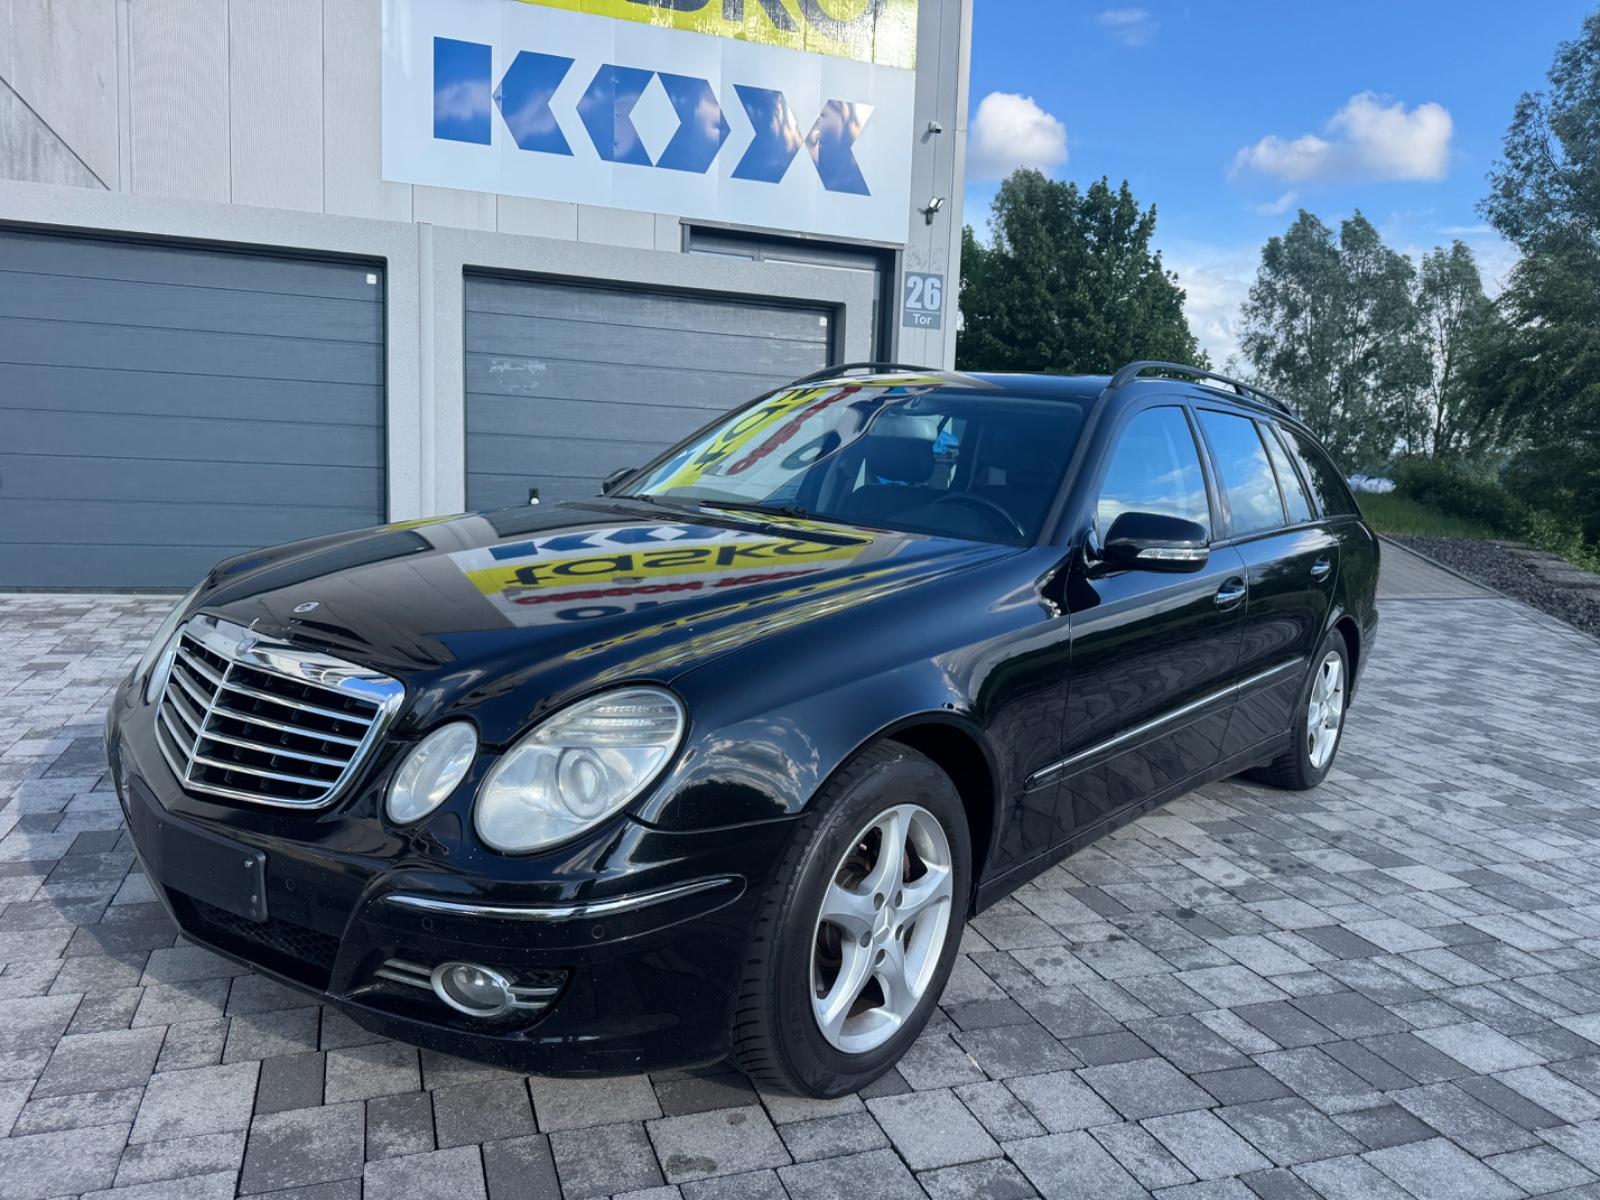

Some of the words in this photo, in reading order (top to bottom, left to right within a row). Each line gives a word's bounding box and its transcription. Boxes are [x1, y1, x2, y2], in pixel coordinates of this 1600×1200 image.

[433, 37, 875, 196] KOX
[906, 276, 941, 310] 26
[912, 313, 933, 325] Tor
